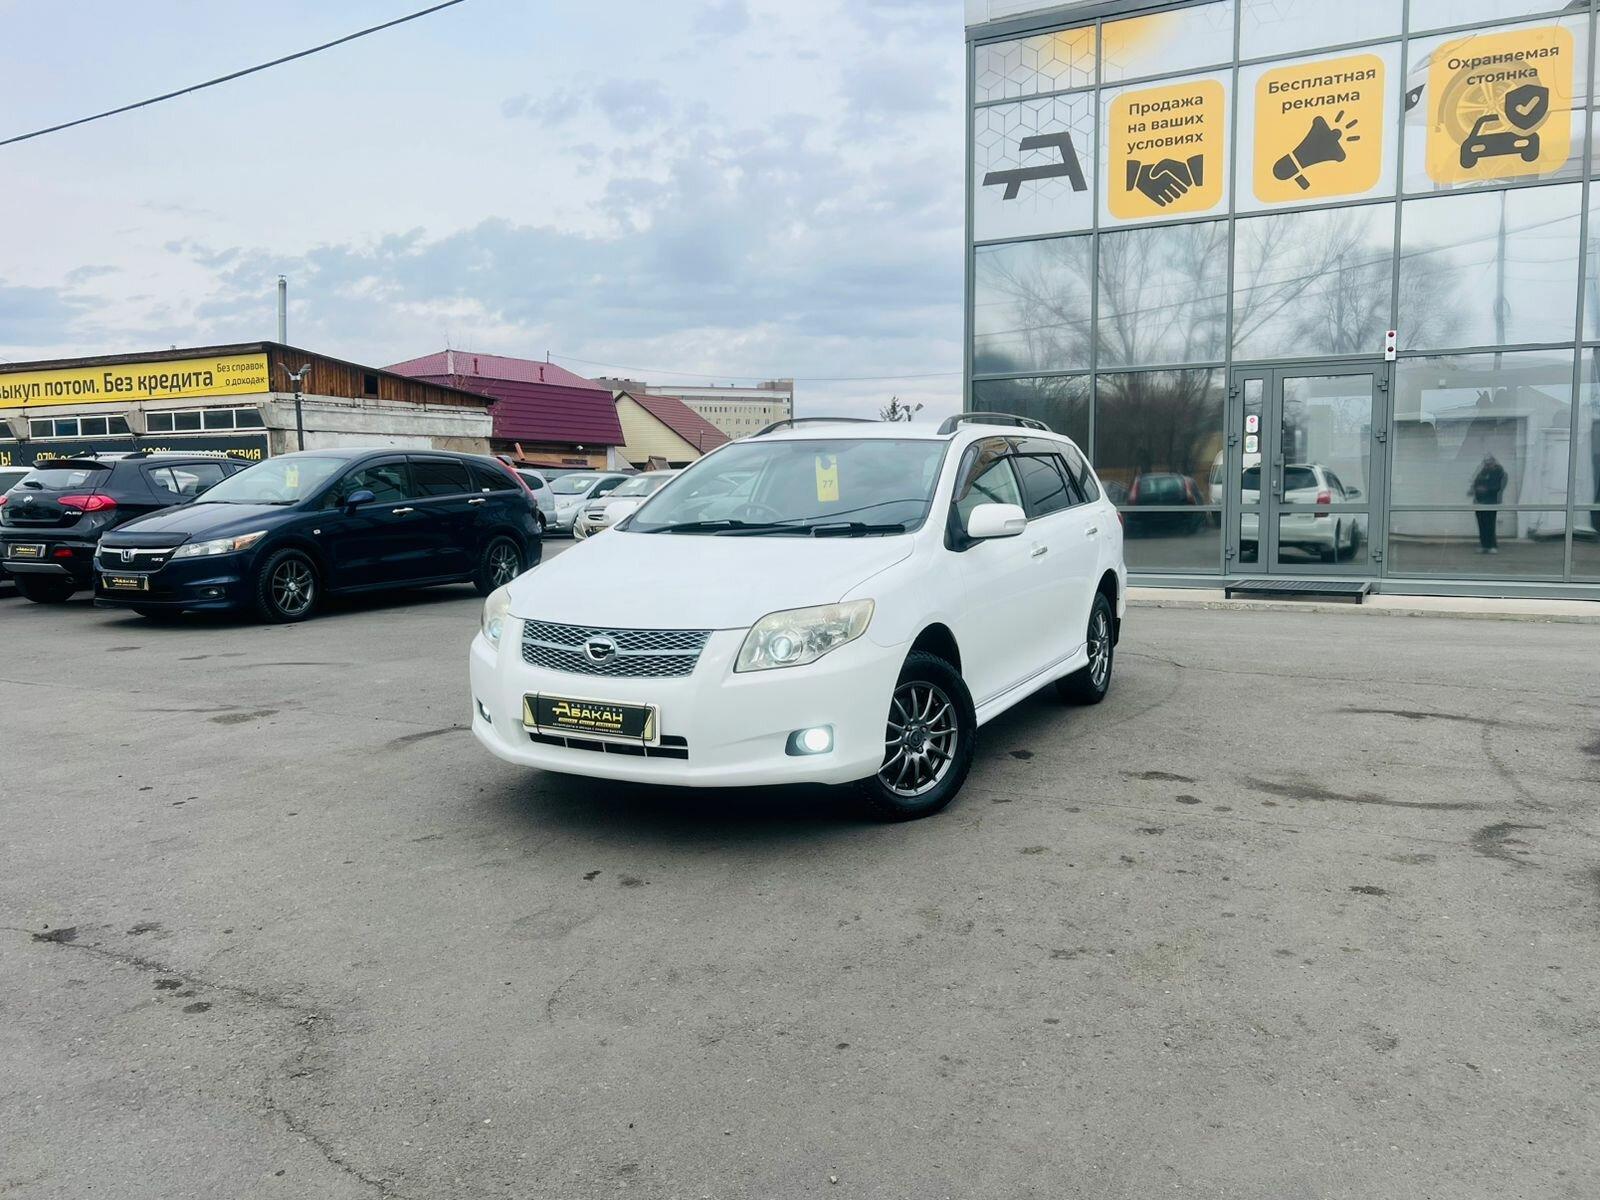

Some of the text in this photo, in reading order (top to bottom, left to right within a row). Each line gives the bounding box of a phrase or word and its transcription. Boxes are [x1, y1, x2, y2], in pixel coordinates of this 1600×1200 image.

[1448, 46, 1559, 70] Охраняемая
[1268, 68, 1376, 94] Бесплатная
[1467, 67, 1538, 86] стоянка
[1129, 95, 1203, 116] Продажа
[1282, 91, 1360, 114] реклама
[1128, 114, 1204, 134] на ваших
[1127, 132, 1203, 155] условиях
[231, 362, 264, 373] справок
[0, 370, 213, 403] ыкуп потом. Без кредита
[231, 376, 265, 387] доходах
